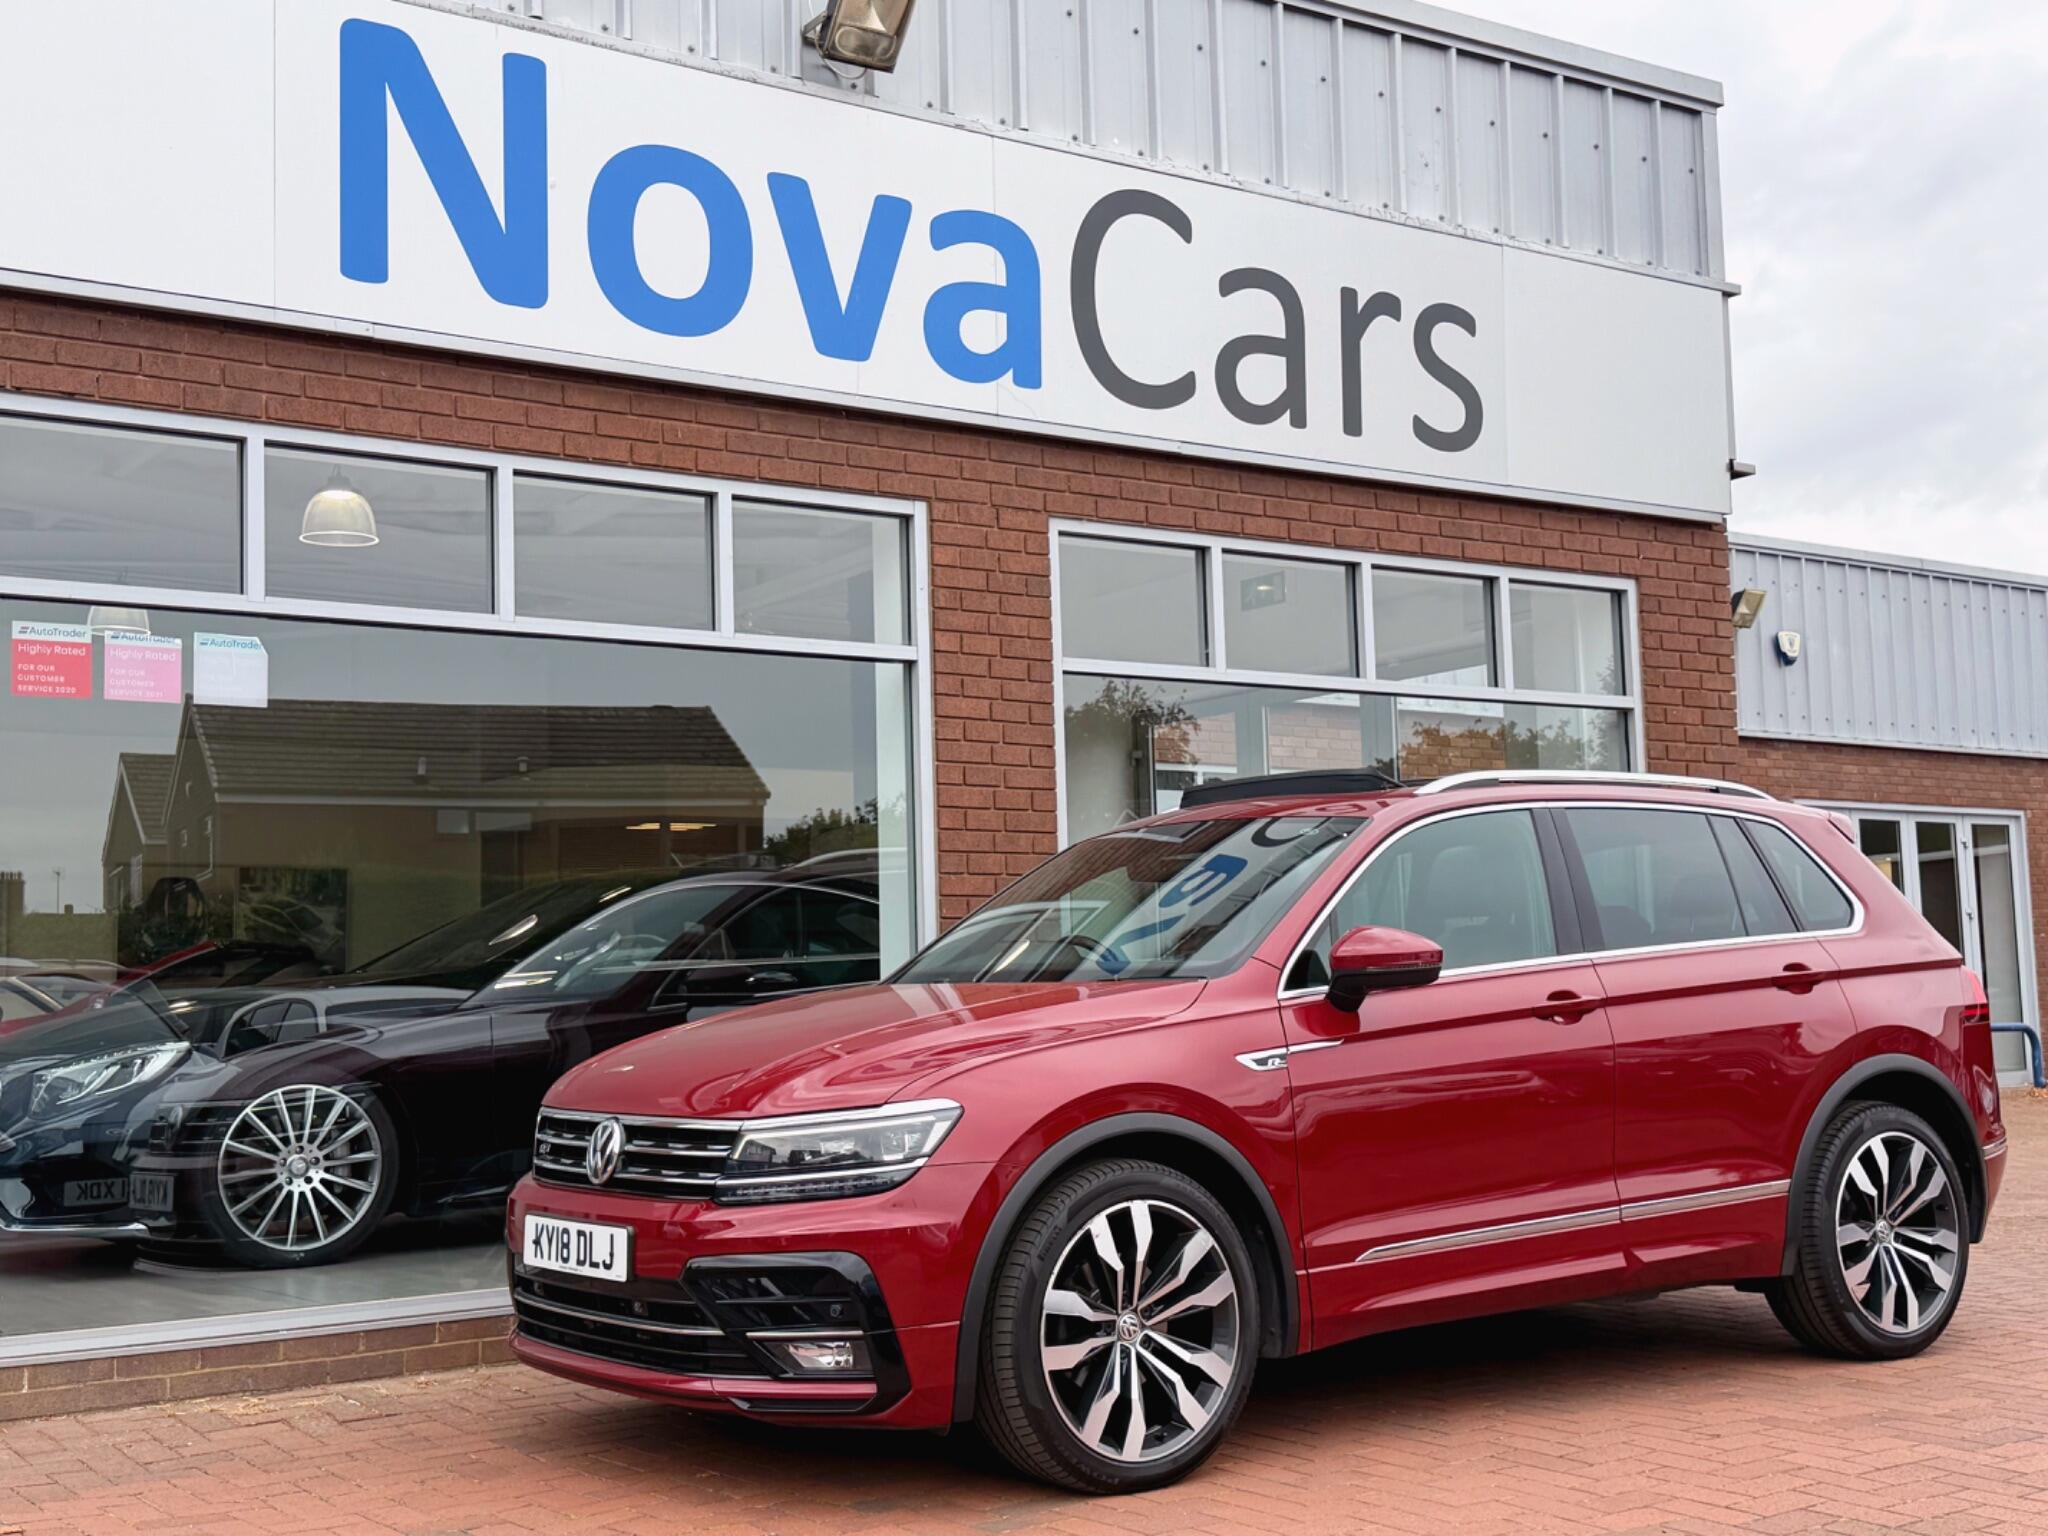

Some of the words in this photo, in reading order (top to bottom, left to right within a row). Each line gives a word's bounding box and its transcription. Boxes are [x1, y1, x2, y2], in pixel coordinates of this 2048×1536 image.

[340, 17, 1484, 453] NovaCars
[29, 626, 87, 638] AutoTrader
[17, 643, 52, 656] Highly
[54, 645, 86, 656] Rated
[17, 663, 35, 671] FOR
[36, 664, 55, 672] OUR
[17, 673, 65, 682] CUSTOMER
[17, 684, 54, 693] SERVICE
[532, 1222, 571, 1264] KY18
[576, 1229, 615, 1271] DLJ
